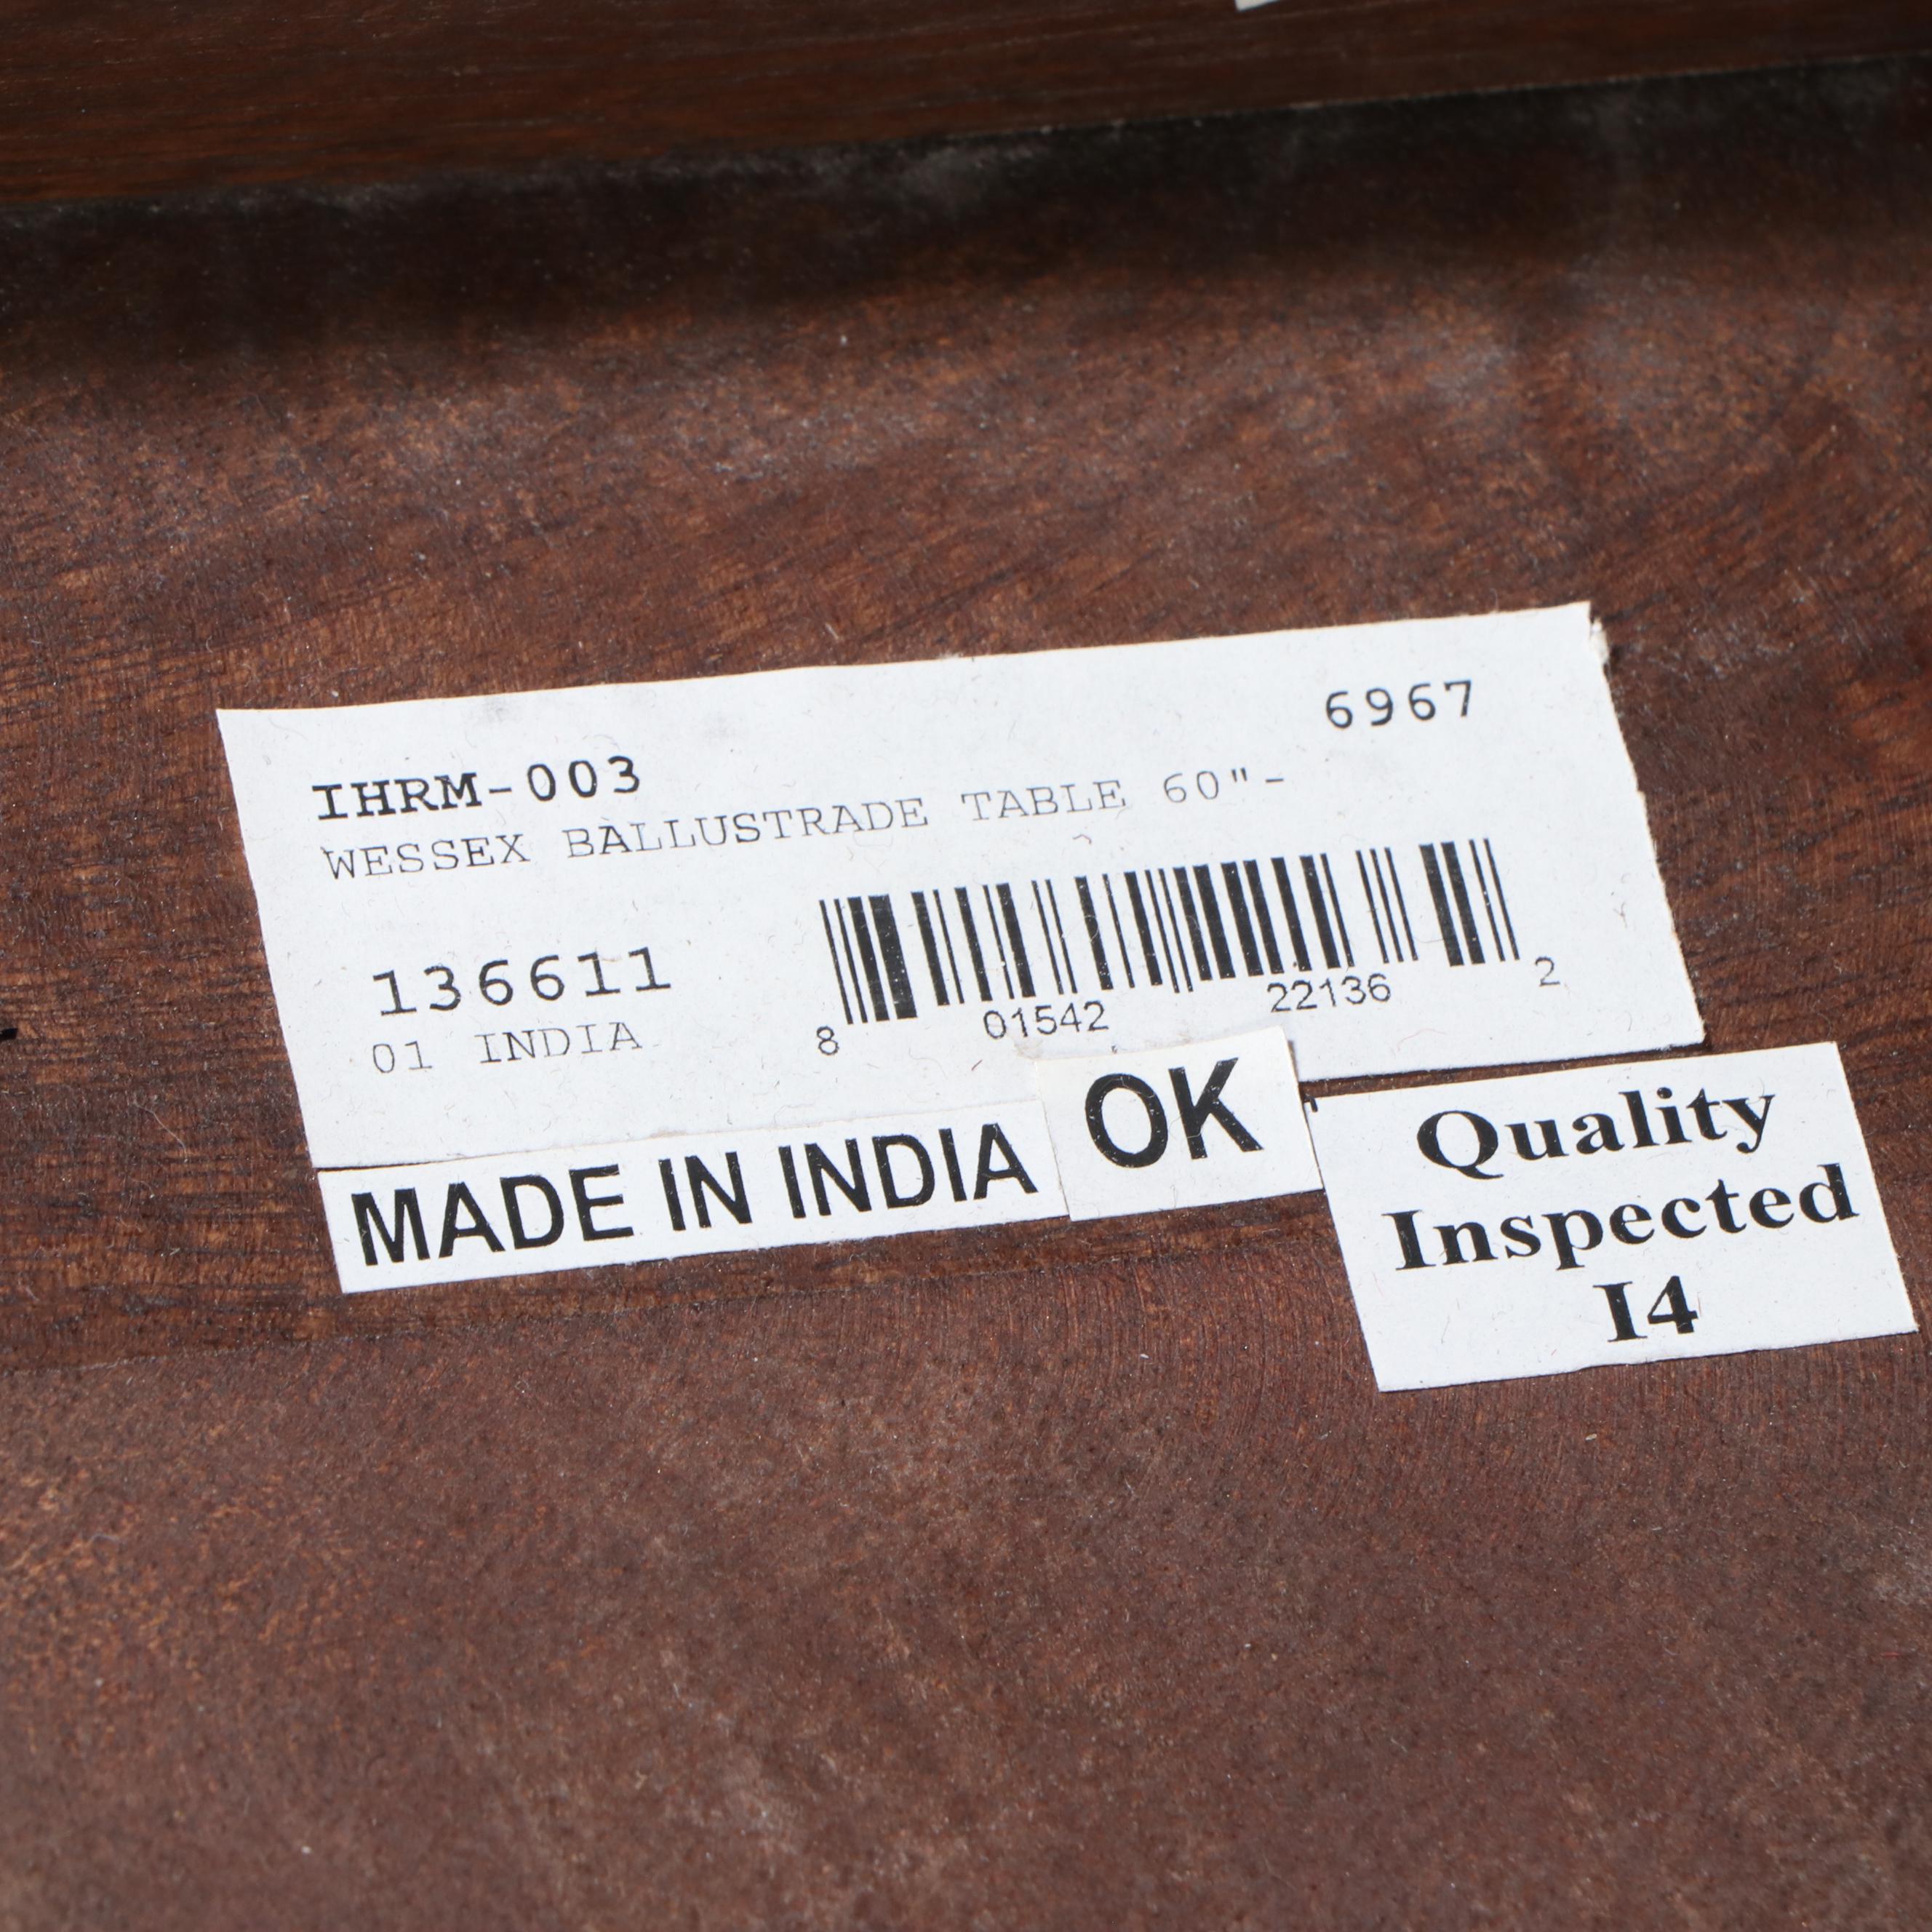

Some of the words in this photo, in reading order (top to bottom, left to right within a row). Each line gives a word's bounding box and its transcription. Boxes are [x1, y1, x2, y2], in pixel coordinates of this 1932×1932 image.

[1325, 680, 1473, 729] 6967
[312, 755, 642, 821] IHRM-003
[321, 834, 532, 882] WESSEX
[564, 797, 928, 858] BALLUSTRADE
[962, 780, 1127, 822] TABLE
[1164, 767, 1285, 805] 60"-
[372, 946, 672, 1017] 136611
[817, 1026, 839, 1055] 8
[983, 1001, 1110, 1039] 01542
[1266, 973, 1392, 1013] 22136
[1536, 957, 1560, 987] 2
[372, 1040, 434, 1074] 01
[476, 1022, 644, 1064] INDIA
[1085, 1057, 1264, 1168] OK
[1416, 1085, 1777, 1178] Quality
[351, 1164, 634, 1266] MADE
[659, 1151, 753, 1232] IN
[778, 1123, 1038, 1219] INDIA
[1384, 1162, 1859, 1272] Inspected
[1592, 1274, 1699, 1344] I4
